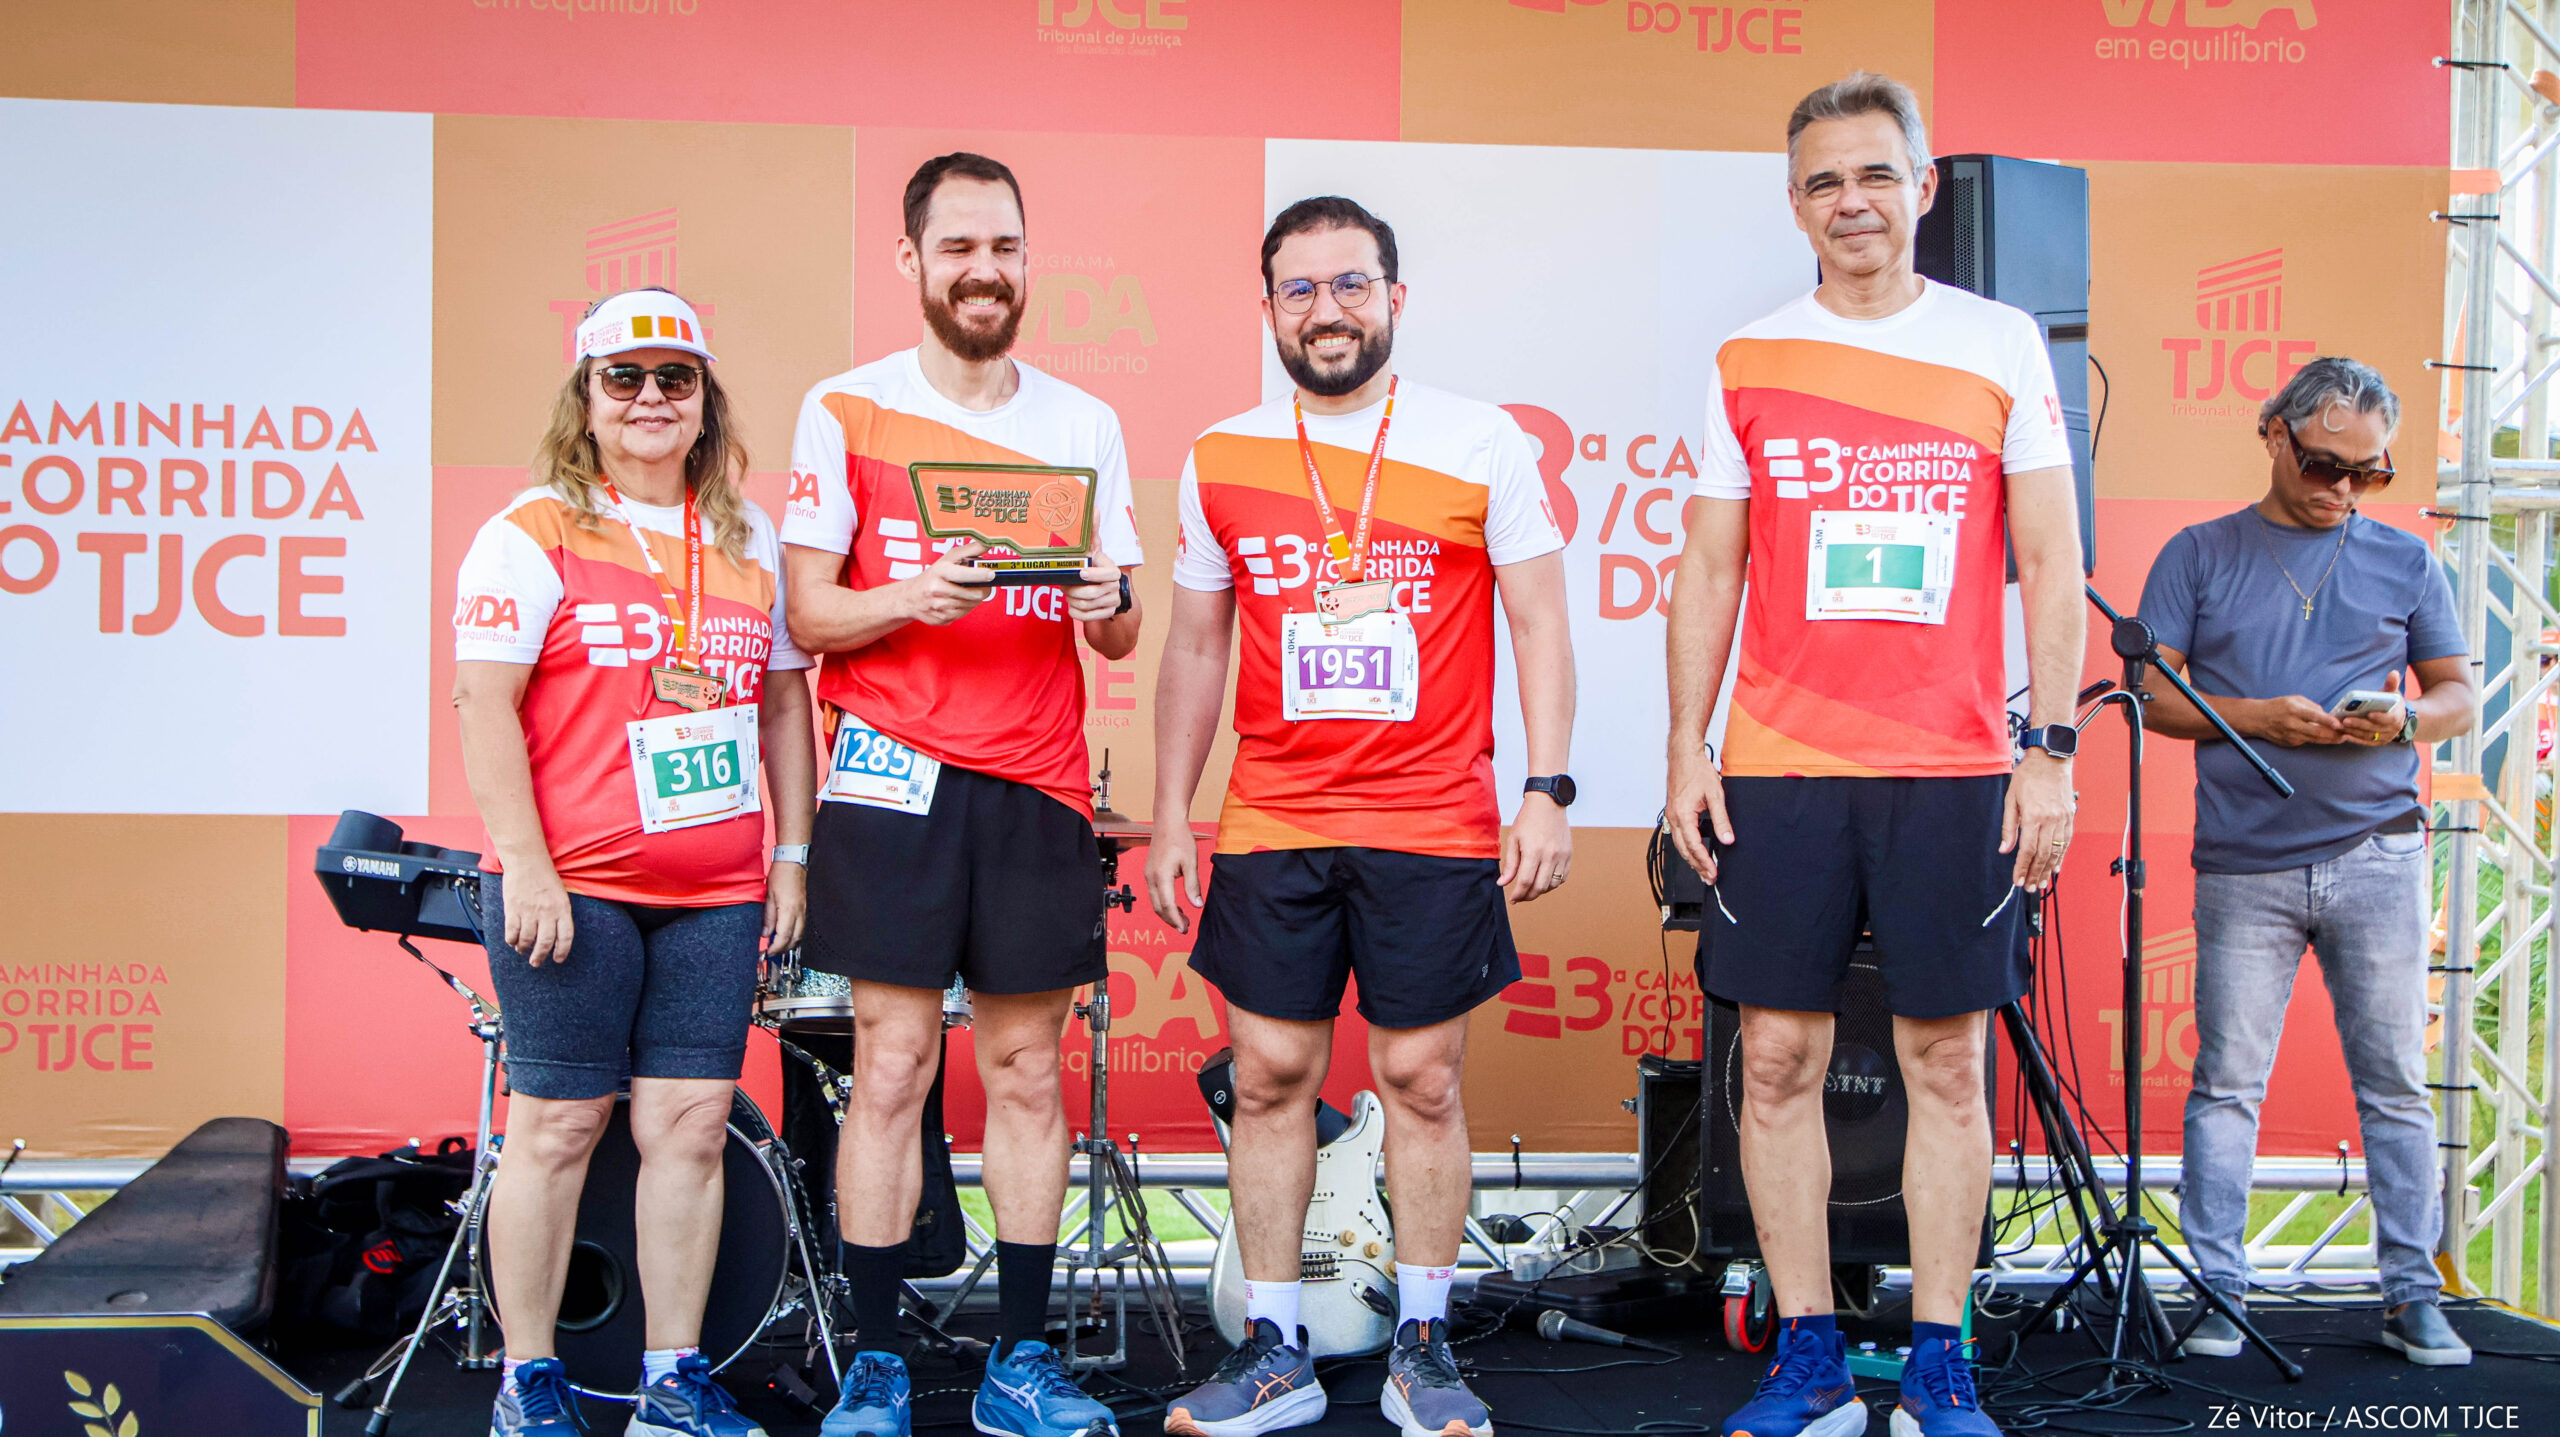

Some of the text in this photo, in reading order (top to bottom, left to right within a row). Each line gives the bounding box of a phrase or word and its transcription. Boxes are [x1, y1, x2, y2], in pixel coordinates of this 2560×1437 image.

[1036, 29, 1182, 48] Tribunal de Justiça
[1627, 1, 1802, 54] DO TJCE
[2095, 31, 2306, 70] em equilíbrio
[2171, 403, 2254, 418] Tribunal de
[1856, 441, 1977, 462] CAMINHADA
[1848, 459, 1973, 484] /CORRIDA
[0, 455, 365, 521] ORRIDA
[978, 489, 1032, 499] CAMINHADA
[1848, 483, 1968, 520] DO TJCE
[974, 507, 1028, 523] DO TJCE
[1815, 529, 1824, 550] 3KM
[1022, 561, 1051, 569] LUGAR
[1865, 547, 1883, 584] 1
[77, 532, 347, 638] TJCE
[1000, 585, 1064, 623] TJCE
[1287, 628, 1296, 655] 10KM
[1301, 648, 1385, 687] 1951
[636, 738, 648, 761] 3KM
[839, 731, 912, 776] 1285
[667, 744, 732, 793] 316
[356, 857, 401, 878] YAMAHA
[27, 1023, 155, 1073] TJCE
